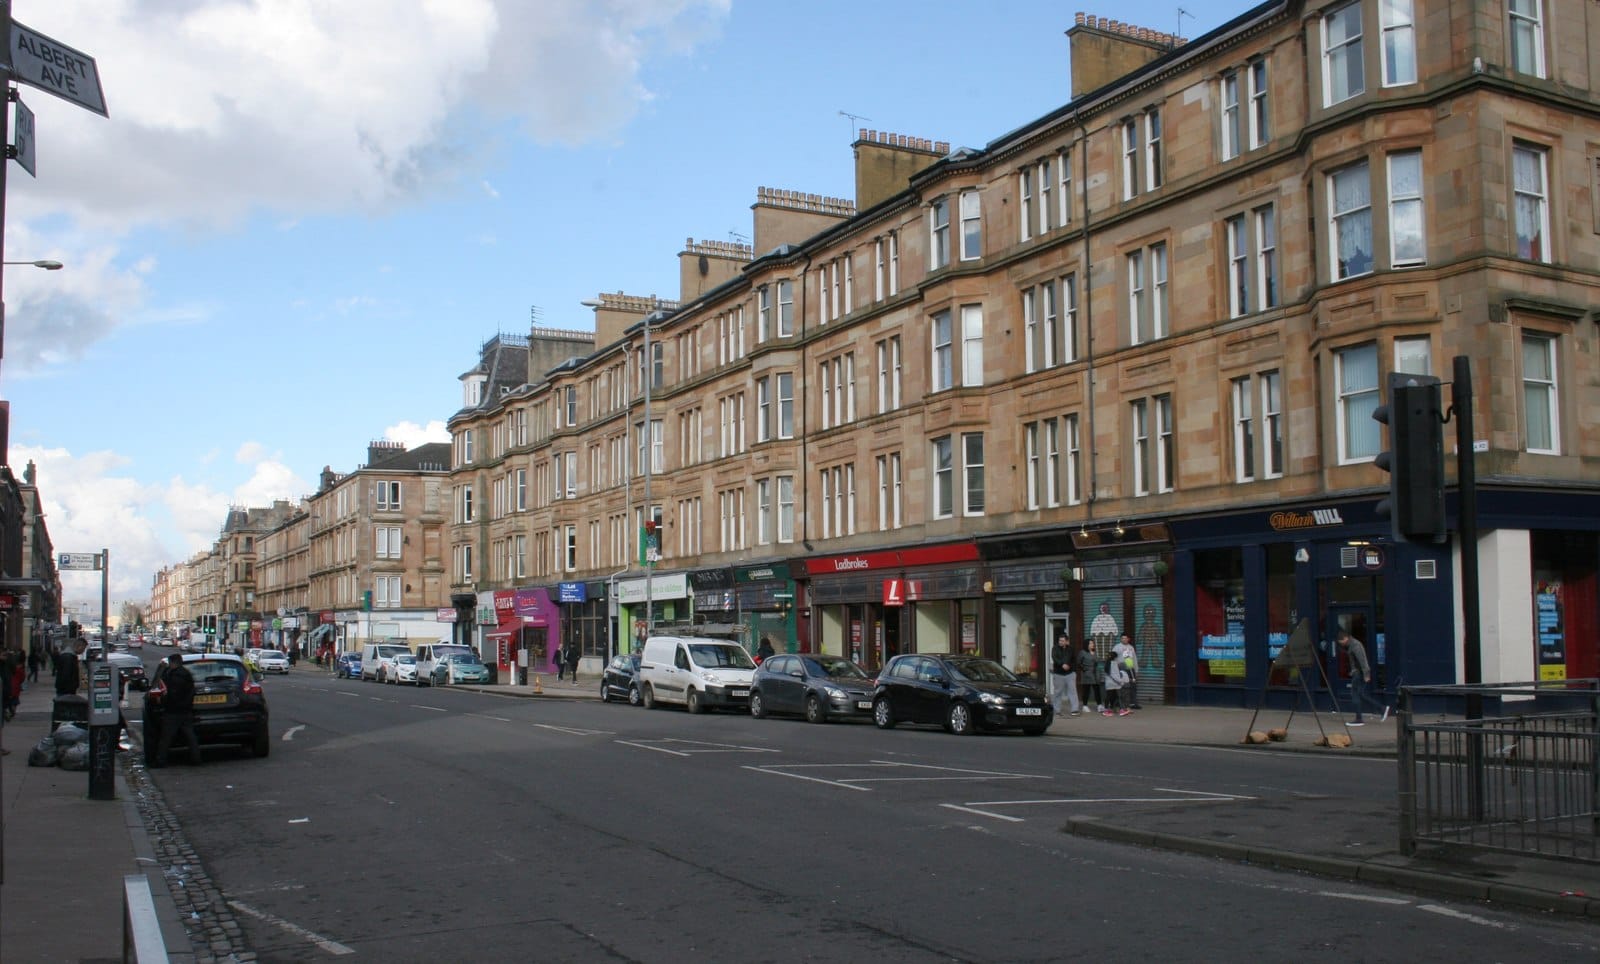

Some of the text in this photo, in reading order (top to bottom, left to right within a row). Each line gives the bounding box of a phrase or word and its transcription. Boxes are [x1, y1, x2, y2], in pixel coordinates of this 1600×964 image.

[18, 33, 87, 79] ALBERT
[41, 66, 78, 96] AVE
[19, 109, 32, 140] RIA
[1269, 508, 1343, 530] William HILL
[834, 557, 869, 570] Ladbrokes
[888, 580, 900, 600] L
